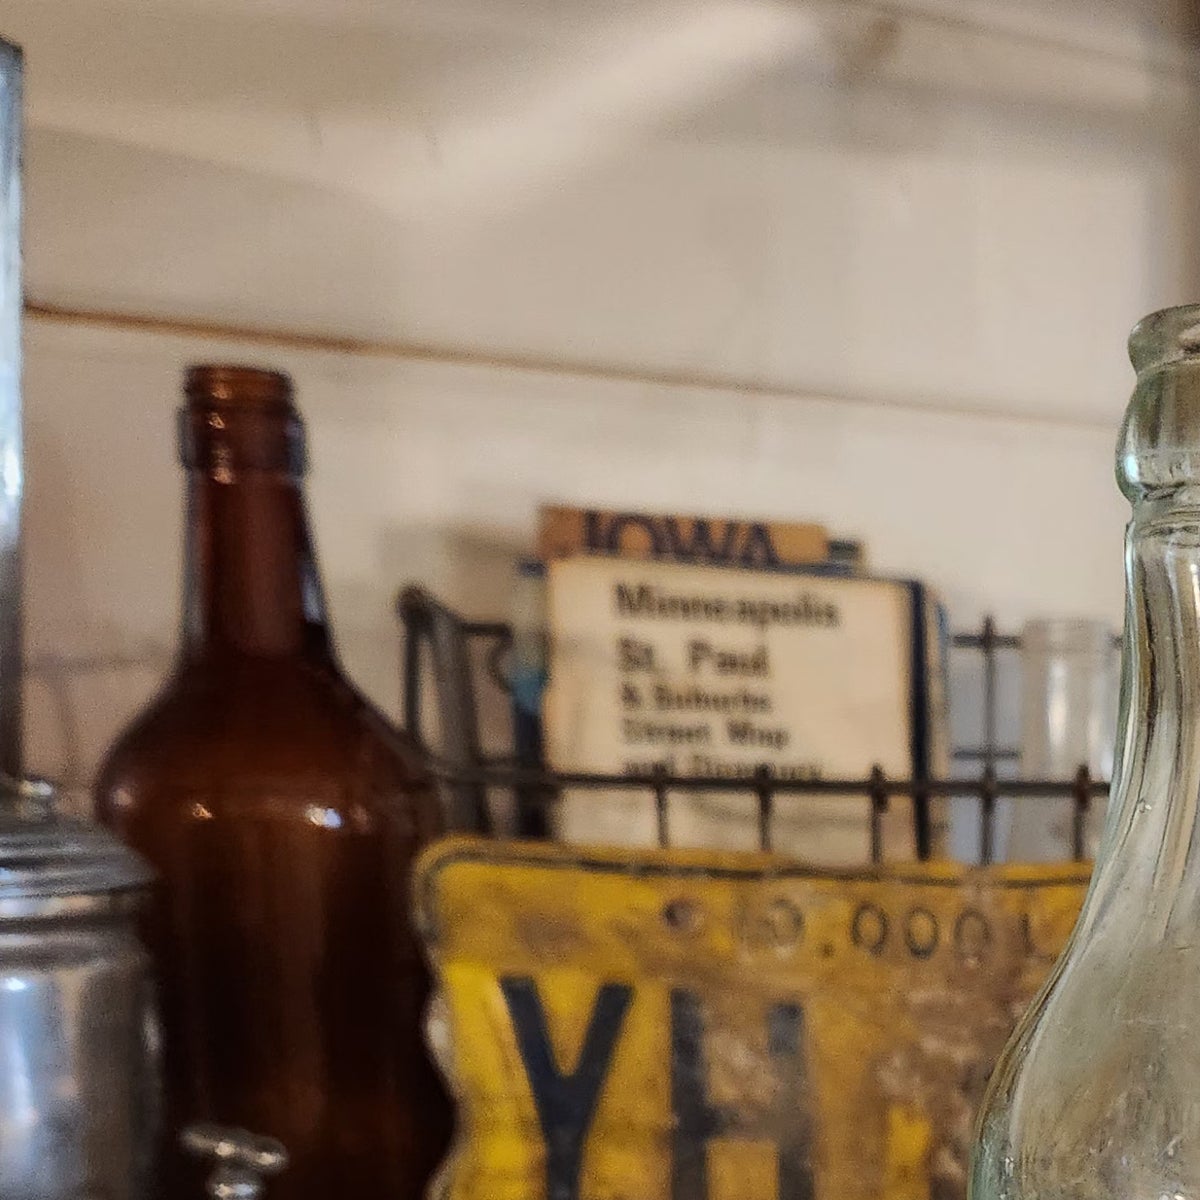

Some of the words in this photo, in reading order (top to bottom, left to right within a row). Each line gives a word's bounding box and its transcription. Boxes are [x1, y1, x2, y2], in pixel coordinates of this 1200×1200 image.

[583, 510, 780, 566] IOWA
[615, 581, 840, 629] Minneapolis
[687, 640, 770, 677] Paul
